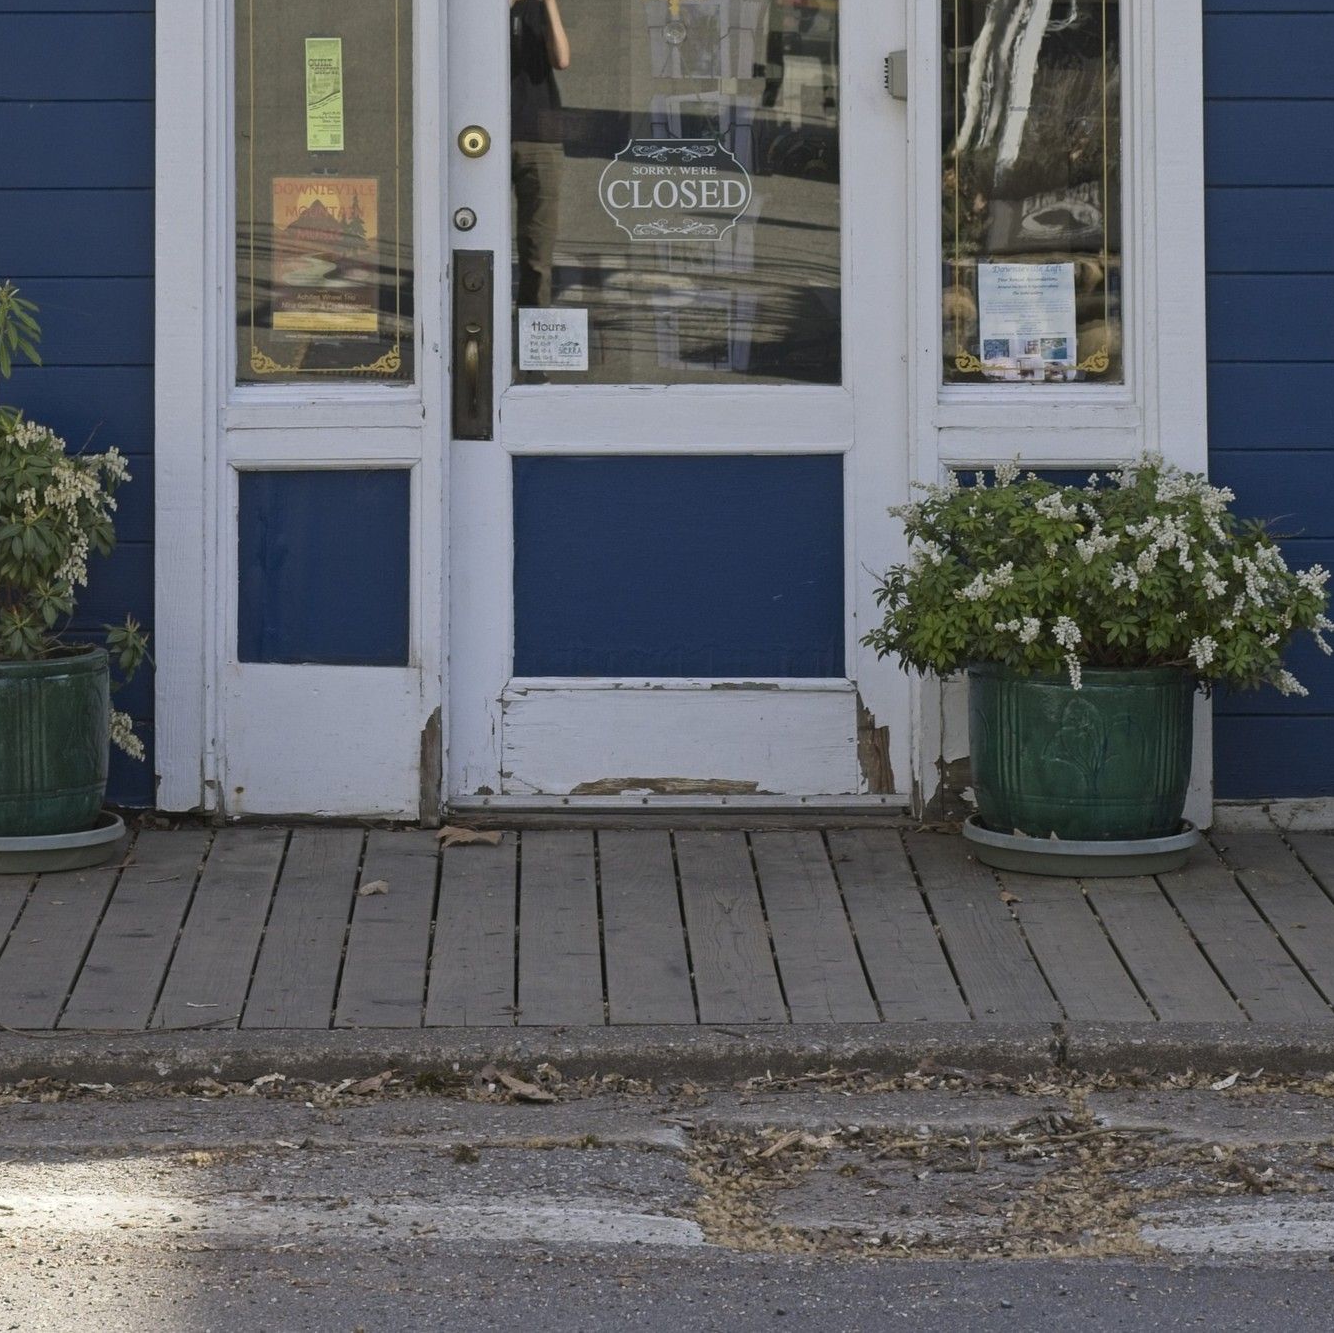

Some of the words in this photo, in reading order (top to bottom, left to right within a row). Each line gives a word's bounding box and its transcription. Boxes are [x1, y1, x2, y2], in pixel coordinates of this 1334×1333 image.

[632, 165, 677, 176] SORRY,
[679, 165, 718, 176] WE'RE
[273, 182, 376, 196] DOWNIEVILLE
[607, 178, 747, 209] CLOSED
[531, 321, 567, 332] Hours
